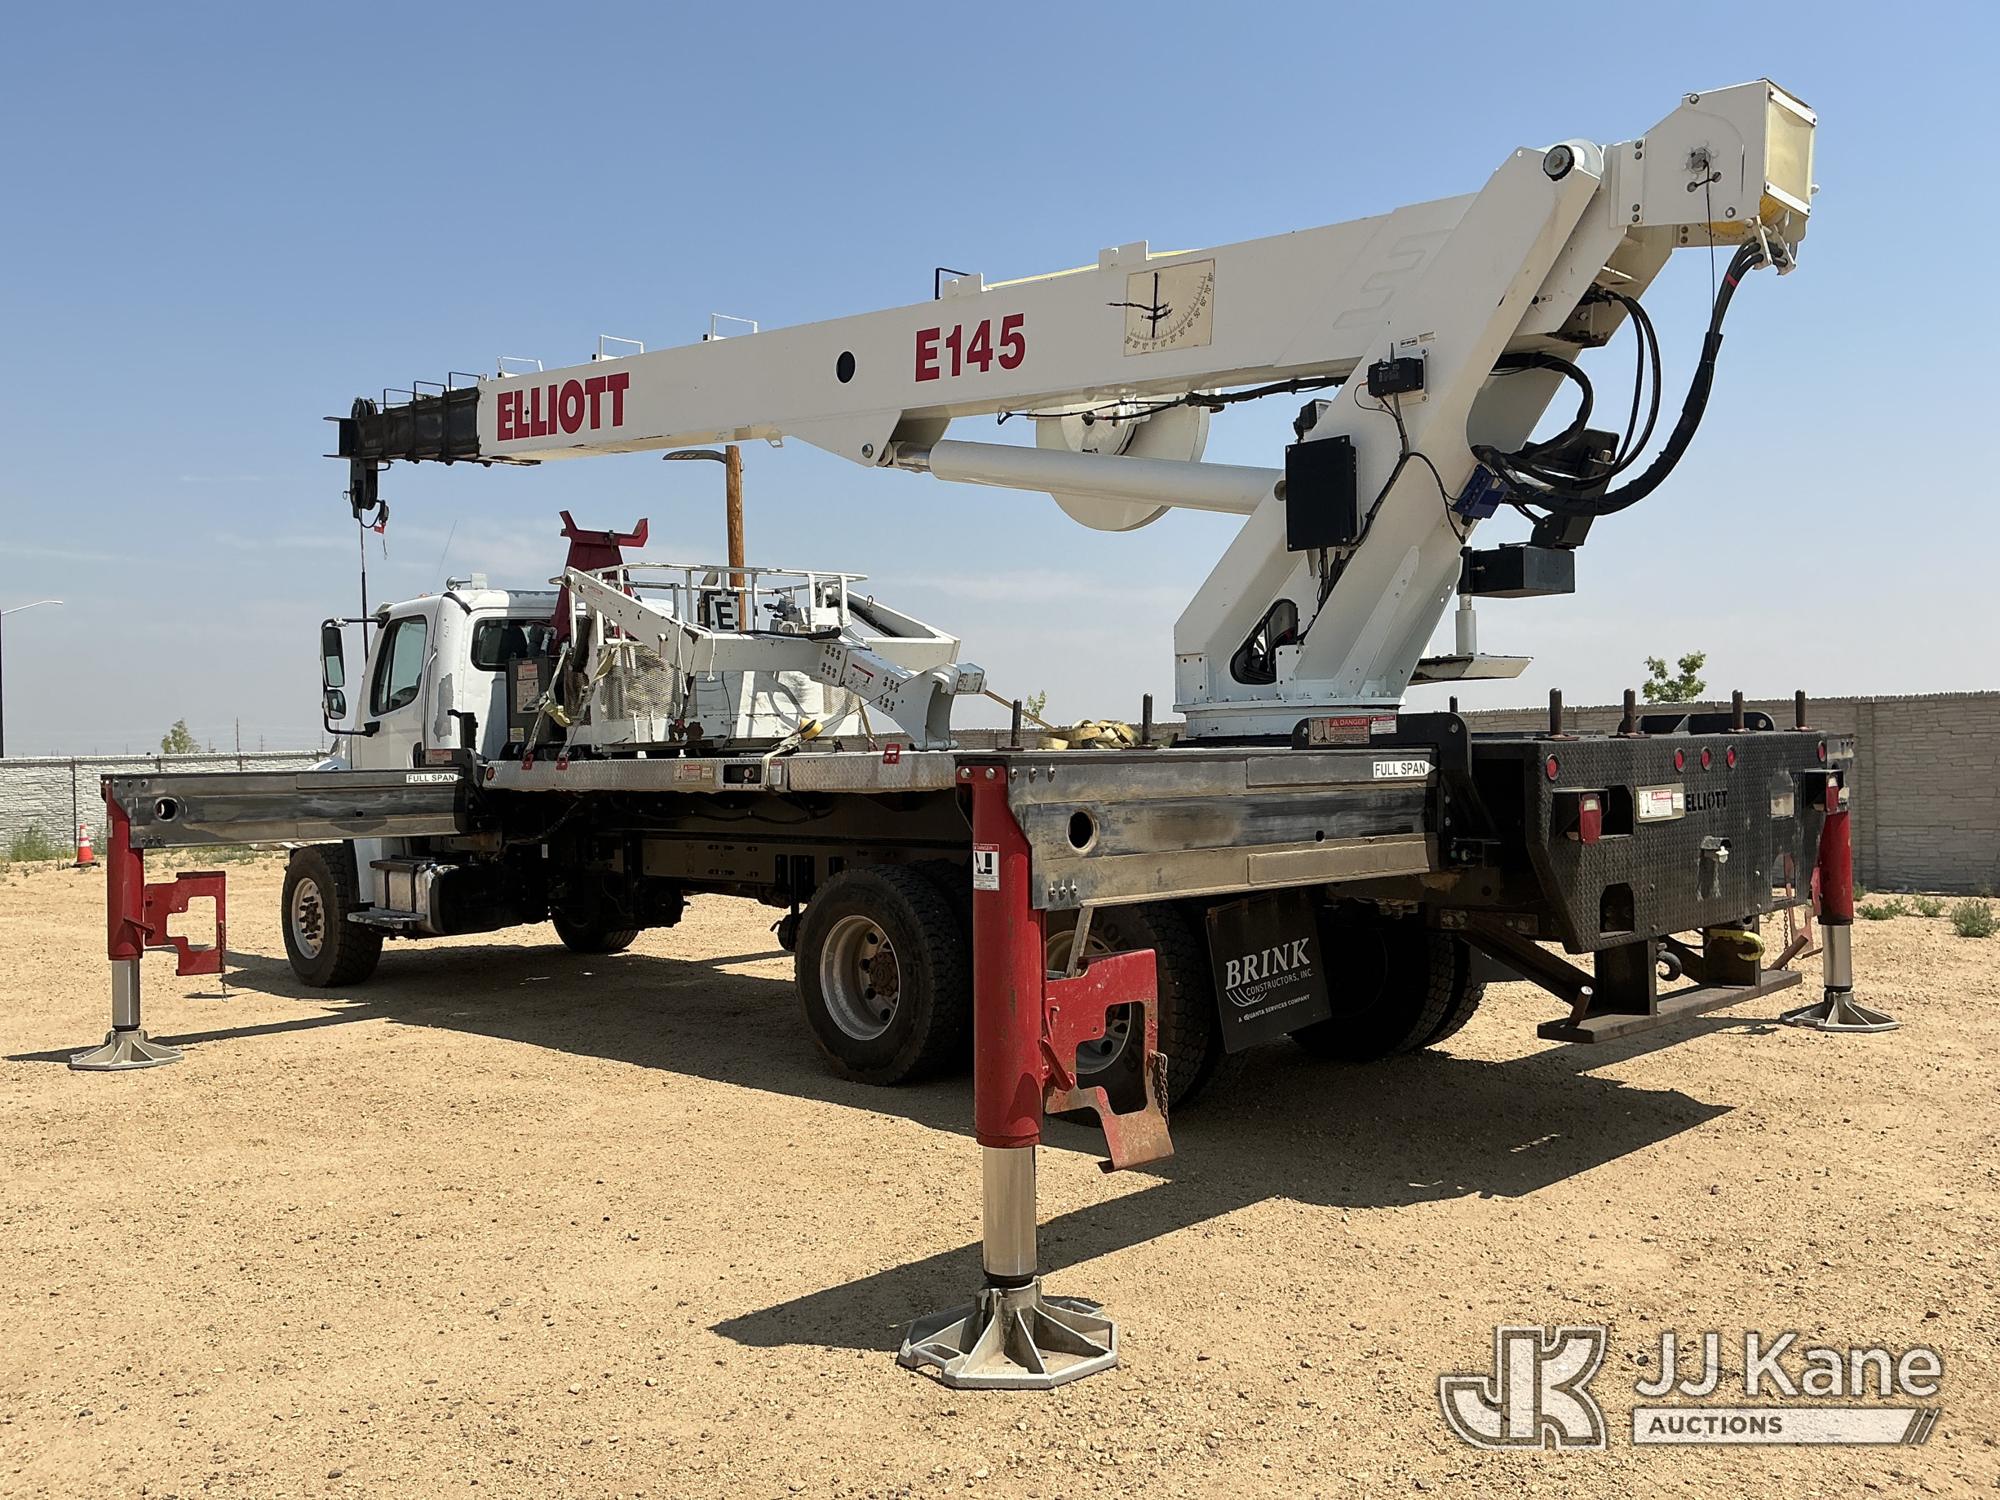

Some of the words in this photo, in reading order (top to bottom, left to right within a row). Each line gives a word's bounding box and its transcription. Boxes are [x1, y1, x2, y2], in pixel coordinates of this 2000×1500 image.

[915, 312, 1026, 383] E145
[497, 372, 630, 441] ELLIOTT
[714, 601, 734, 630] E
[1340, 718, 1367, 727] DANGER
[431, 774, 455, 782] SPAN
[1375, 763, 1398, 776] FULL
[1400, 762, 1426, 775] SPAN
[1685, 790, 1728, 813] ELLIOTT
[1225, 937, 1311, 991] BRINK
[1246, 972, 1300, 996] CONSTRUCTORS,
[1243, 1009, 1265, 1021] QUANTA
[1265, 1001, 1288, 1013] SERVICES
[1287, 993, 1311, 1006] COMPANY
